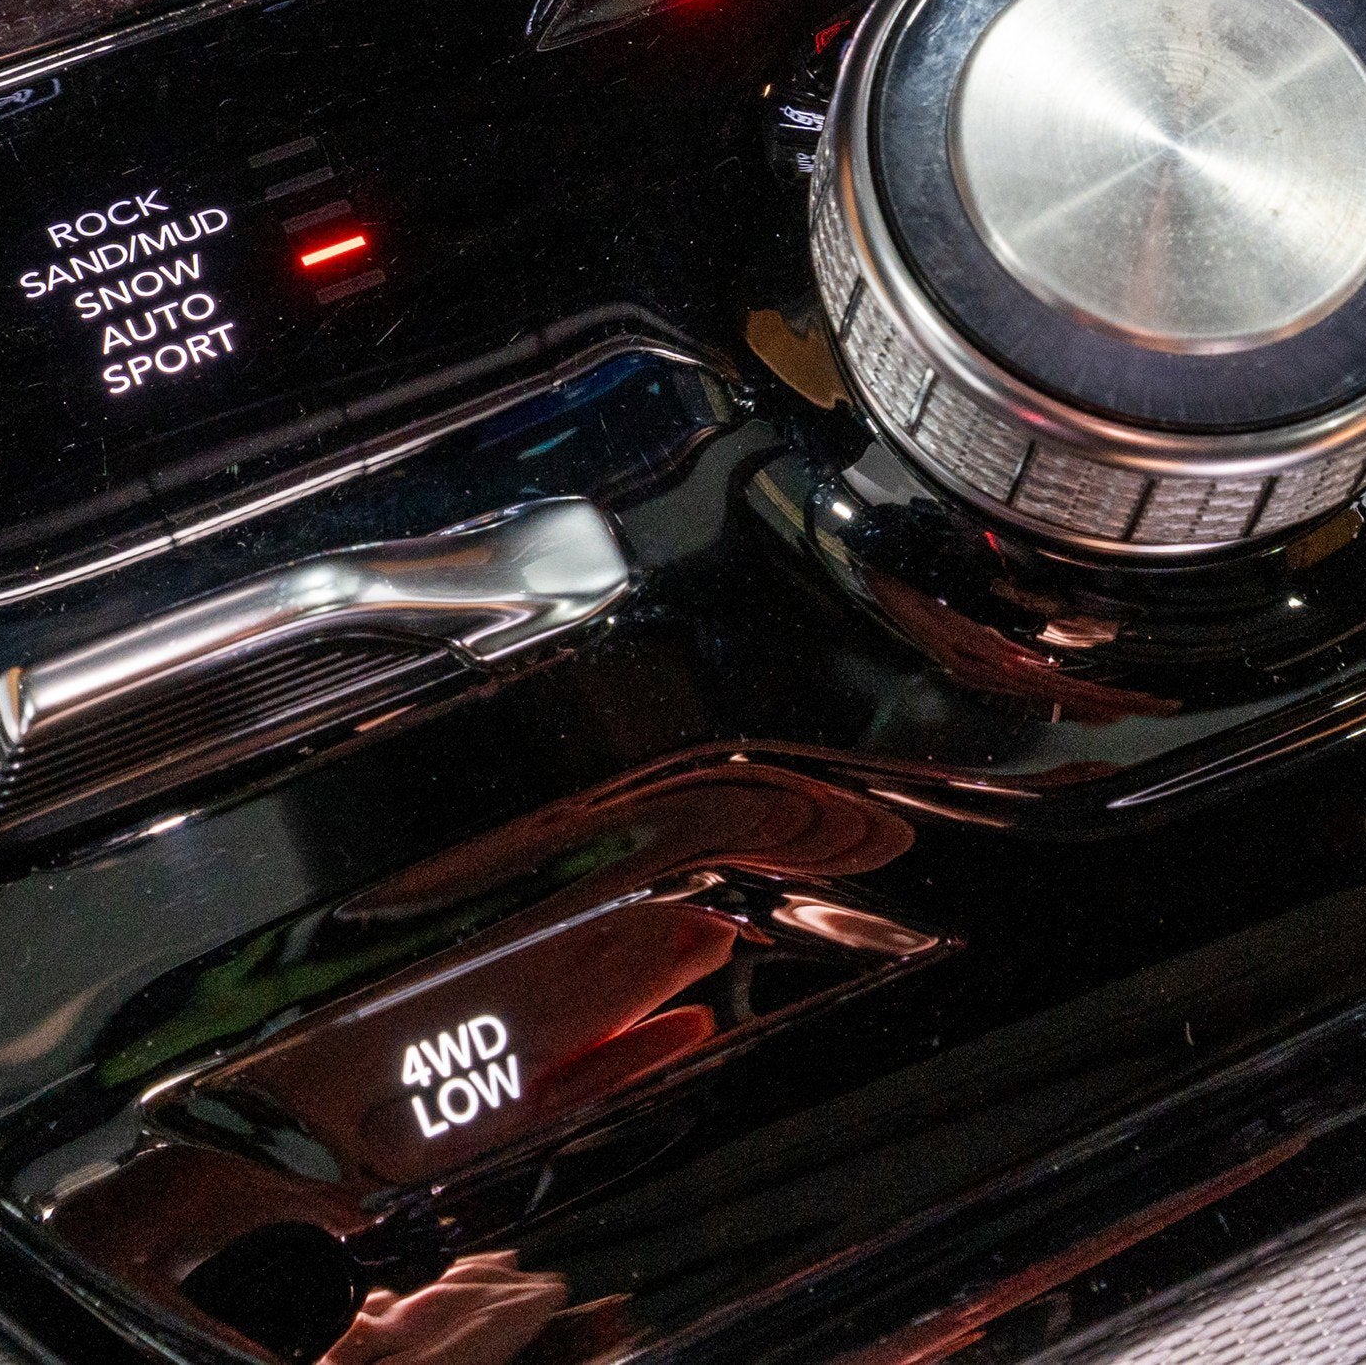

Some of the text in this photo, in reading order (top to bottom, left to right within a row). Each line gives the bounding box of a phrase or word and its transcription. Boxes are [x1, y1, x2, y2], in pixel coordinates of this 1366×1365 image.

[19, 208, 228, 299] SAND/MUD
[47, 189, 169, 249] ROCK
[74, 253, 202, 319] SNOW
[101, 293, 216, 355] AUTO
[102, 322, 234, 395] SPORT
[400, 1014, 508, 1088] 4WD
[411, 1053, 521, 1139] LOW
